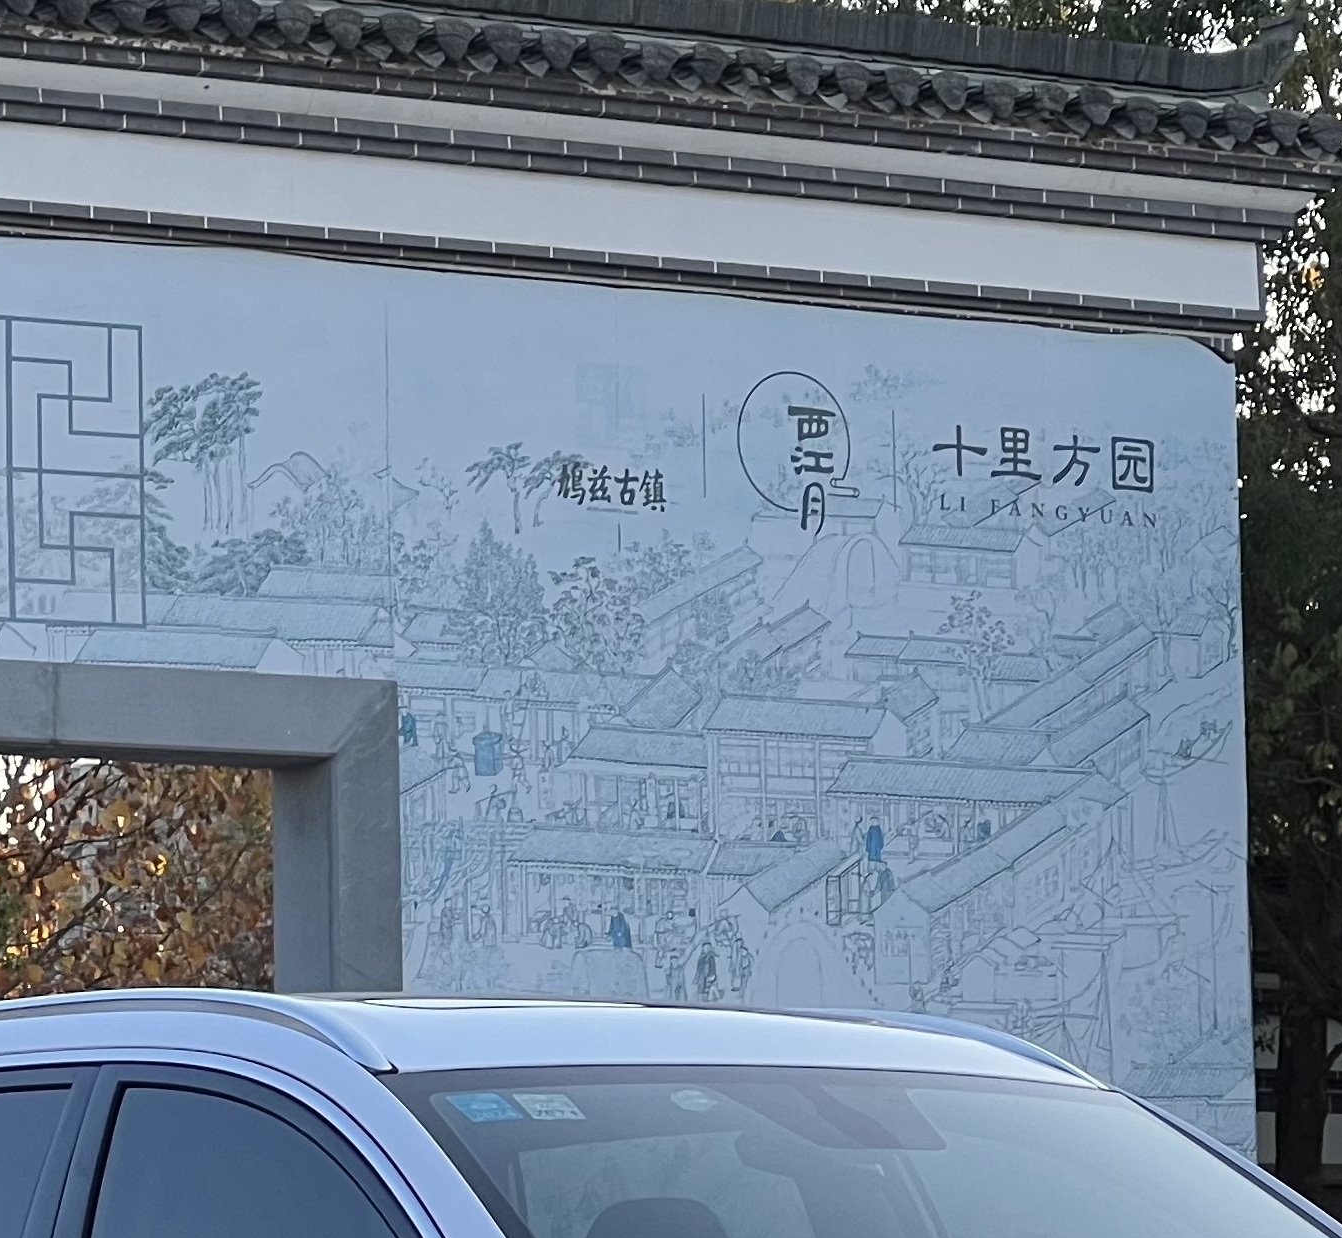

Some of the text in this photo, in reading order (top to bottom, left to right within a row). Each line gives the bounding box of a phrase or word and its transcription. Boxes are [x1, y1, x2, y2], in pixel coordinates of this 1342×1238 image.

[787, 404, 837, 537] 西江月
[932, 424, 1155, 494] 十里方园
[940, 493, 967, 512] LI
